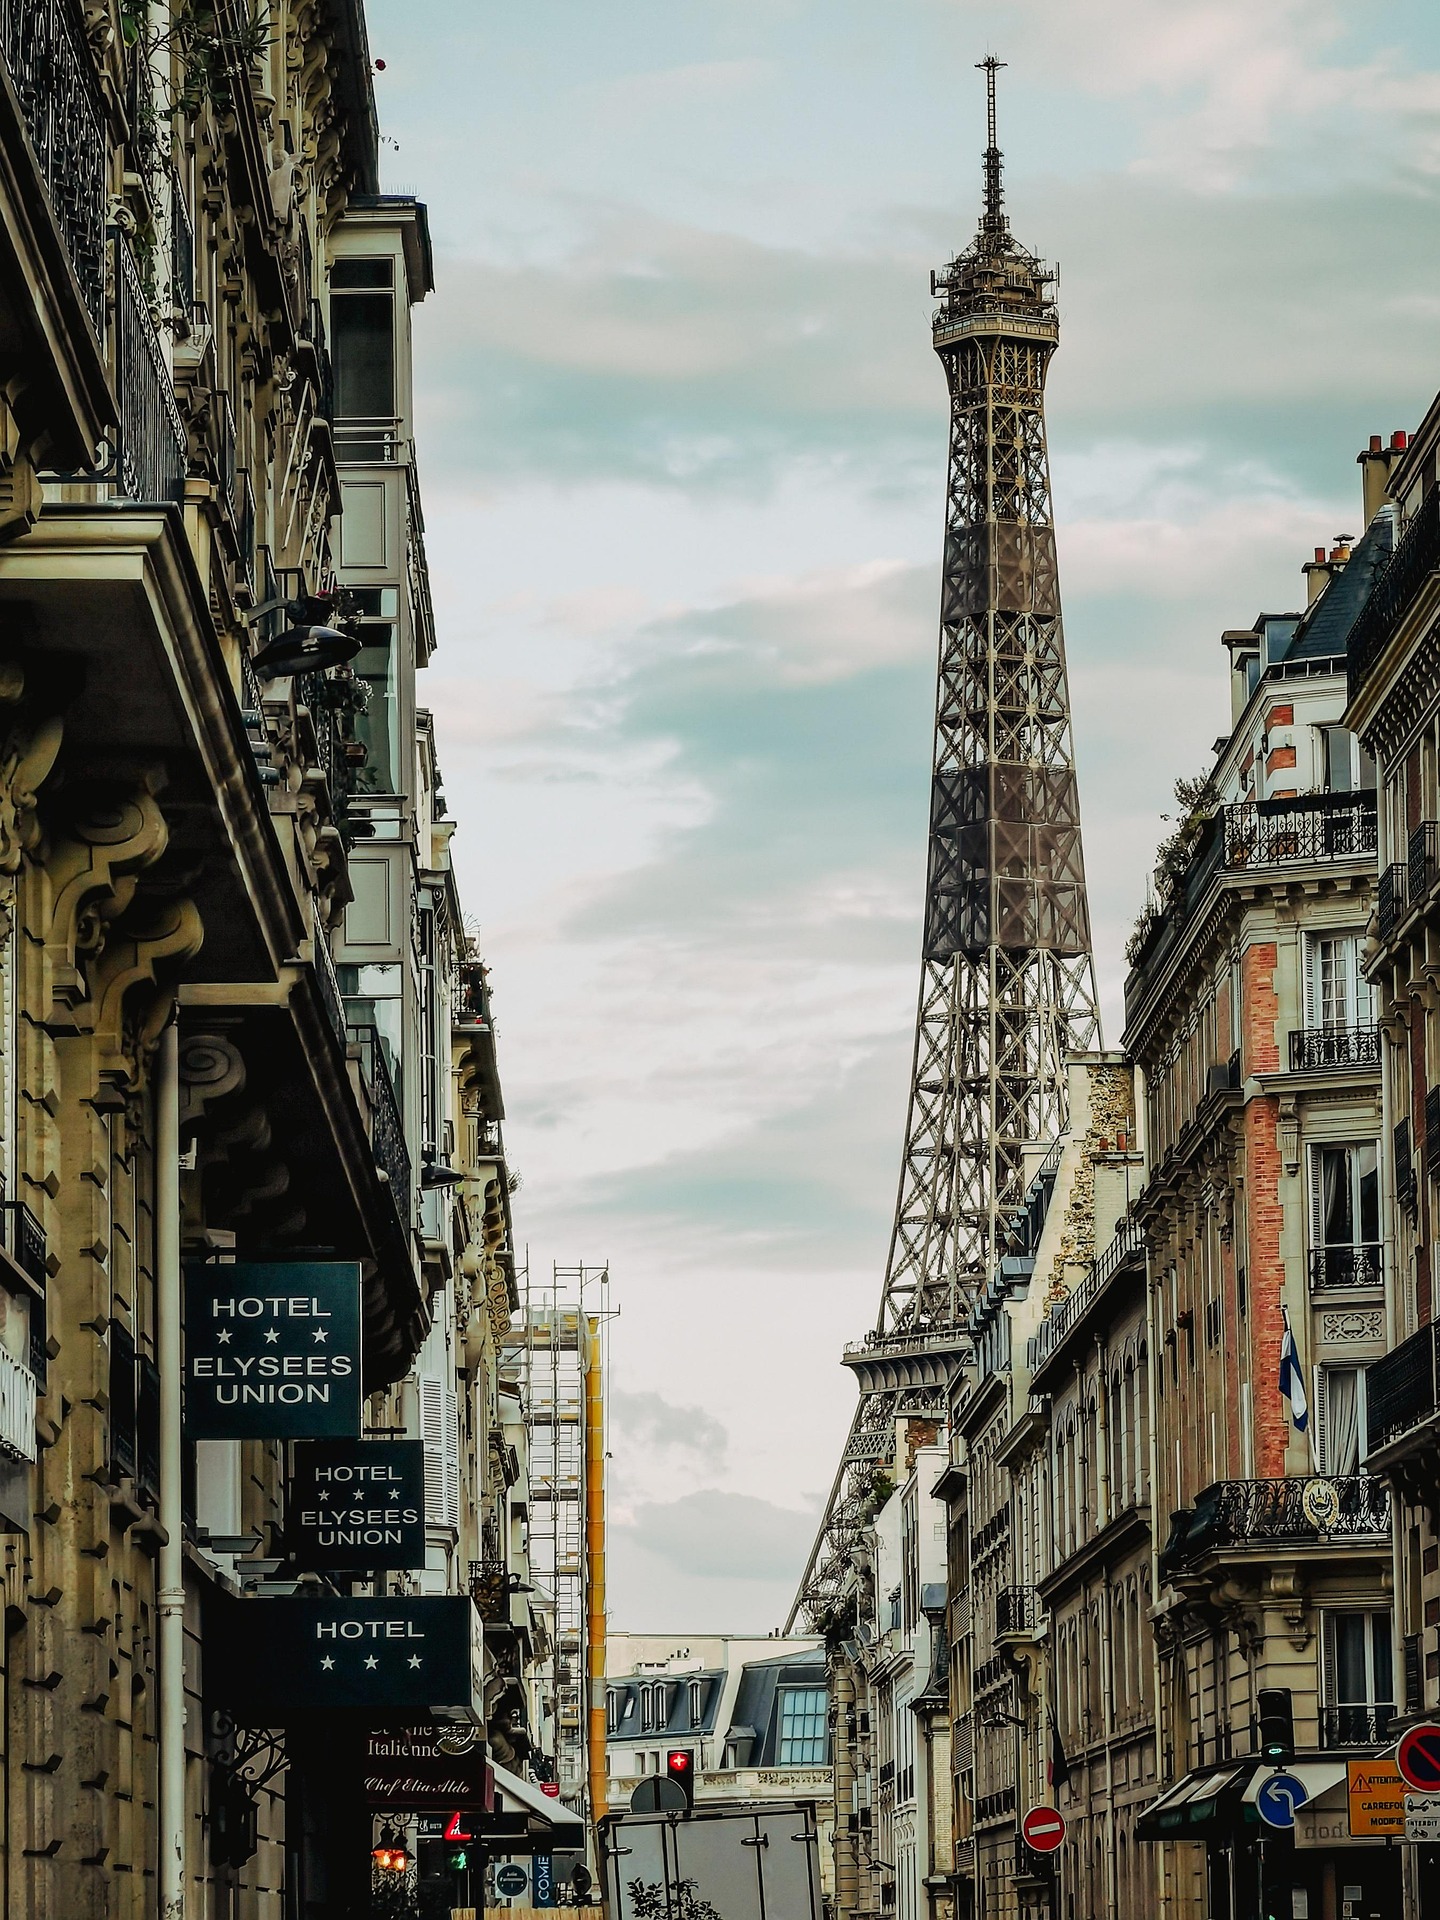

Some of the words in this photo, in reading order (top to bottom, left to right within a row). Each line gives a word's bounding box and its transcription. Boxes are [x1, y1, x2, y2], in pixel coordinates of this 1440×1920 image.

[212, 1297, 332, 1318] HOTEL
[193, 1355, 353, 1378] ELYSEES
[216, 1383, 330, 1404] UNION
[314, 1466, 403, 1482] HOTEL
[301, 1508, 419, 1526] ELYSEES
[317, 1529, 402, 1546] UNION
[316, 1620, 425, 1639] HOTEL
[368, 1739, 441, 1757] Italienne
[364, 1777, 401, 1797] Chef
[1361, 1801, 1405, 1811] CARREFOU
